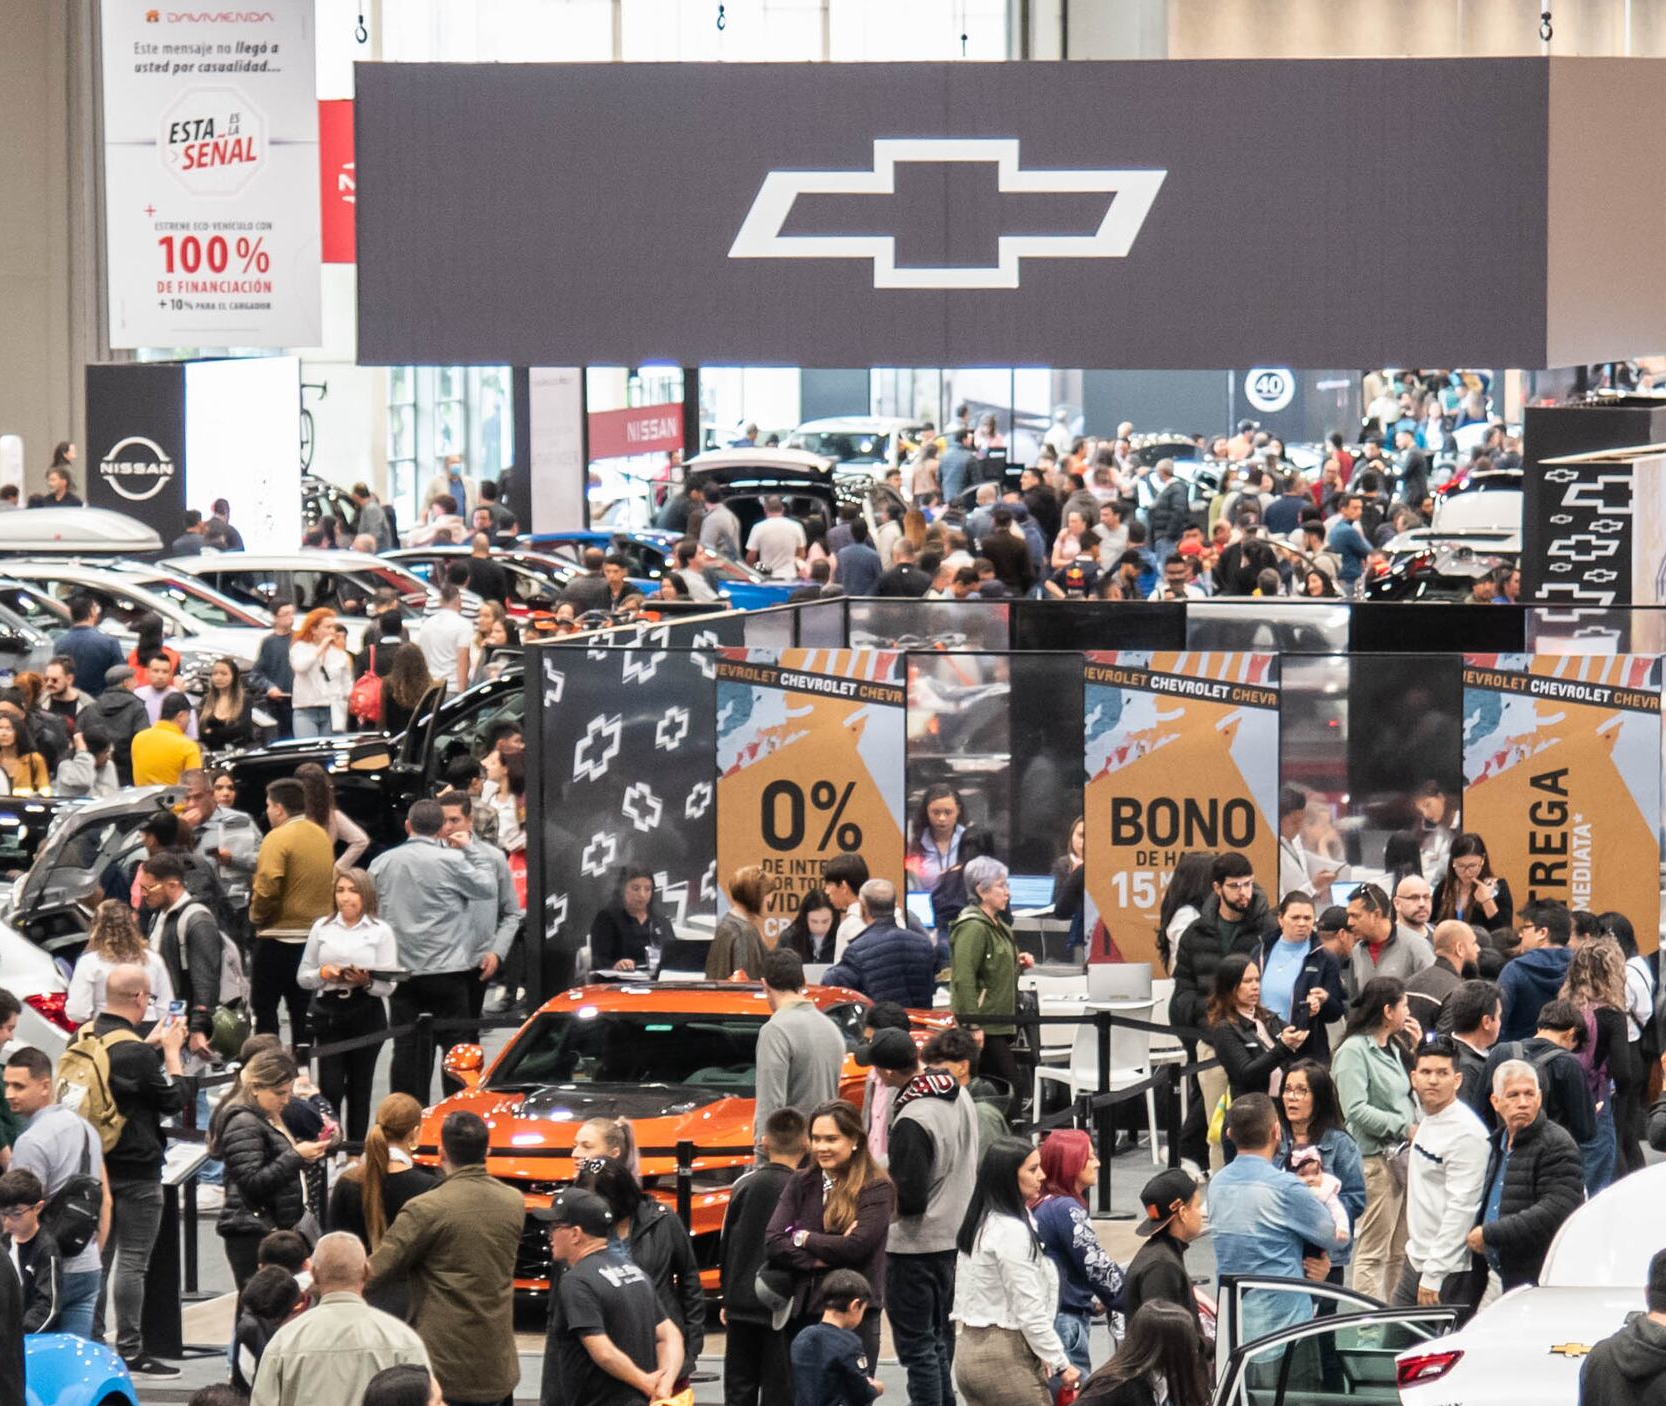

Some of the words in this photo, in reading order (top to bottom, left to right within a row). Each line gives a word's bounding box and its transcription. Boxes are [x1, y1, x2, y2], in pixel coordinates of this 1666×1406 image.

[134, 42, 158, 55] Este
[162, 43, 213, 58] mensaje
[217, 44, 232, 55] no
[235, 41, 268, 57] llegó
[271, 44, 280, 54] a
[134, 60, 170, 73] usted
[172, 62, 195, 76] por
[197, 60, 281, 74] casualidad...
[169, 117, 215, 146] ESTA
[181, 133, 258, 171] SEÑAL
[255, 222, 272, 231] CON
[157, 281, 173, 294] DE
[177, 279, 272, 294] FINANCIACIÓN
[171, 299, 194, 311] 10%
[626, 416, 678, 443] NISSAN
[100, 461, 175, 476] NISSAN
[780, 673, 857, 696] CHEVROLET
[859, 684, 904, 703] CHEVR
[1150, 675, 1230, 699] CHEVROLET
[1232, 688, 1278, 706] CHEVR
[1530, 679, 1612, 703] CHEVROLET
[1613, 692, 1660, 710] CHEVR
[760, 778, 863, 853] 0%
[1111, 796, 1256, 848] BONO
[763, 859, 784, 875] DE
[1136, 851, 1158, 866] DE
[1111, 871, 1156, 909] 15
